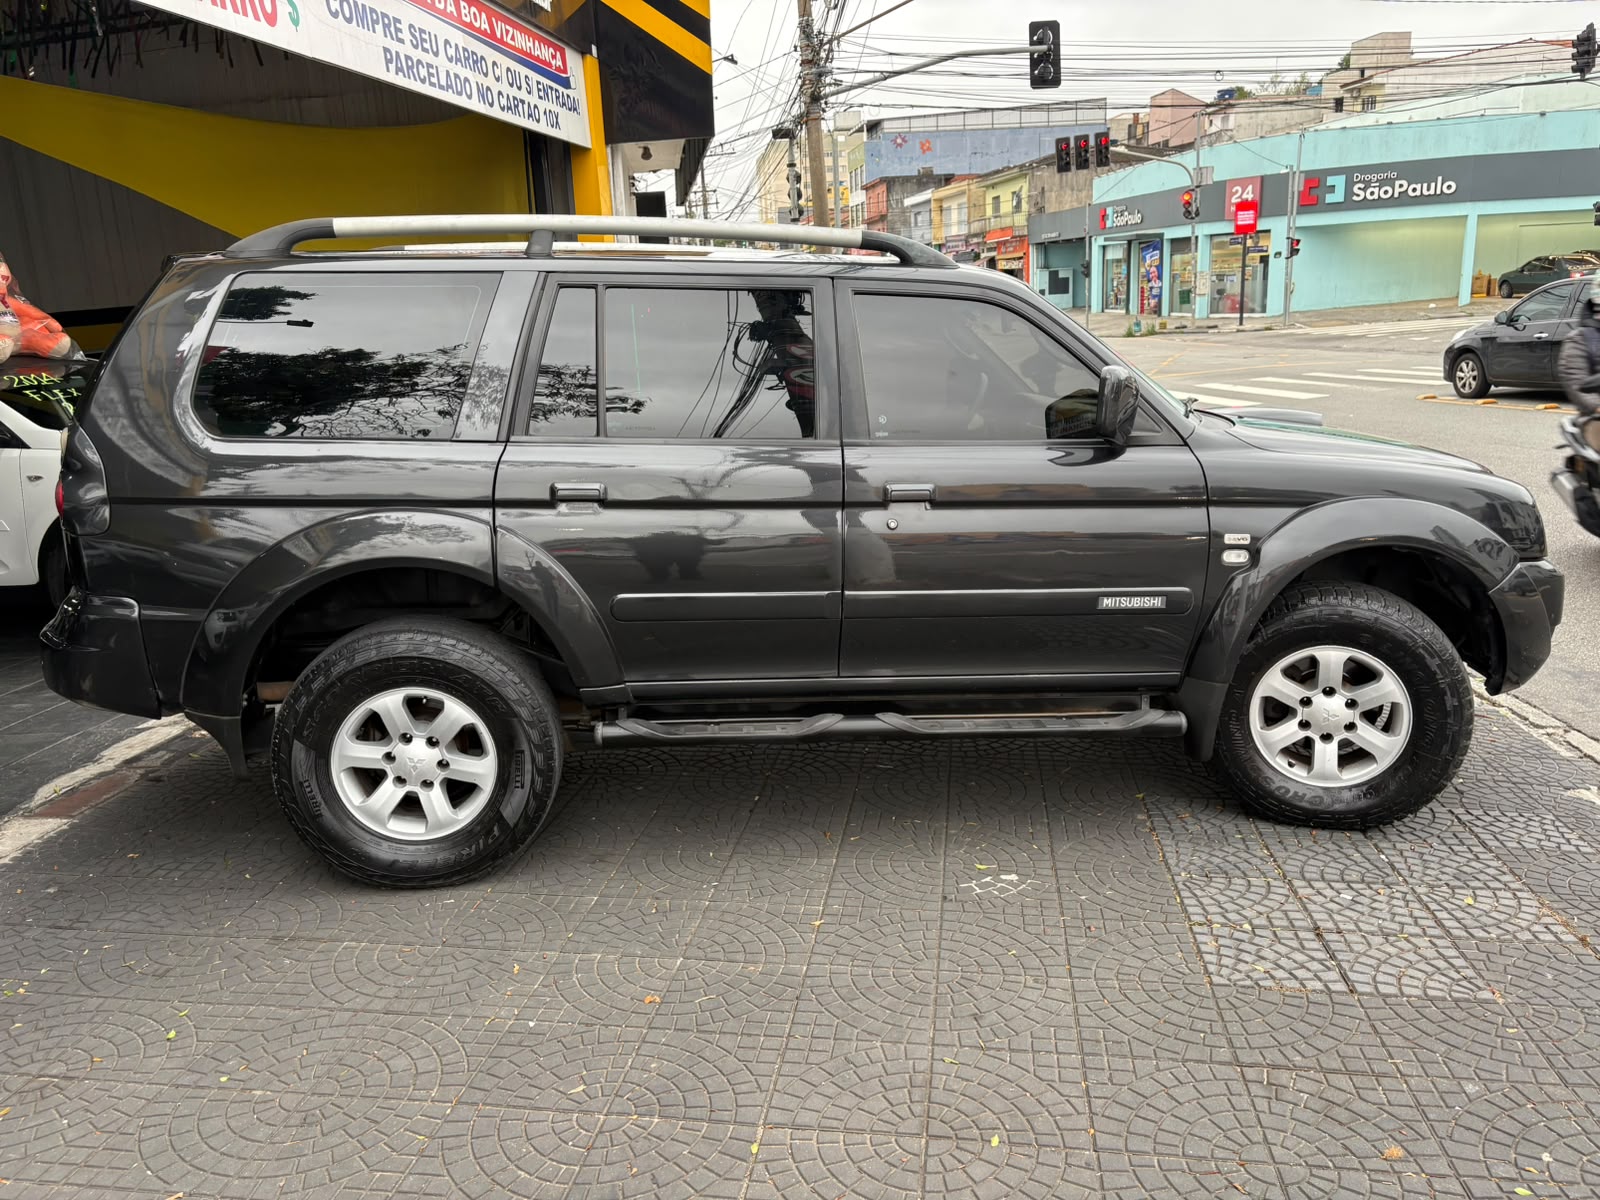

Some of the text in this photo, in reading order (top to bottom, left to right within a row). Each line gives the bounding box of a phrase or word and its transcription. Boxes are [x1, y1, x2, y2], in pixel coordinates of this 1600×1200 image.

[460, 0, 491, 34] BOA
[492, 17, 564, 71] VIZINHANÇA
[325, 0, 405, 45] COMPRE
[408, 23, 439, 58] SEU
[444, 38, 489, 78] CARRO
[506, 66, 522, 92] OU
[537, 80, 581, 116] ENTRADA!
[382, 46, 473, 100] PARCELADO
[476, 81, 494, 109] NO
[543, 107, 562, 131] 10X
[1231, 185, 1254, 203] 24
[1353, 171, 1398, 182] Drogaria
[1103, 596, 1162, 608] MITSUBISHI
